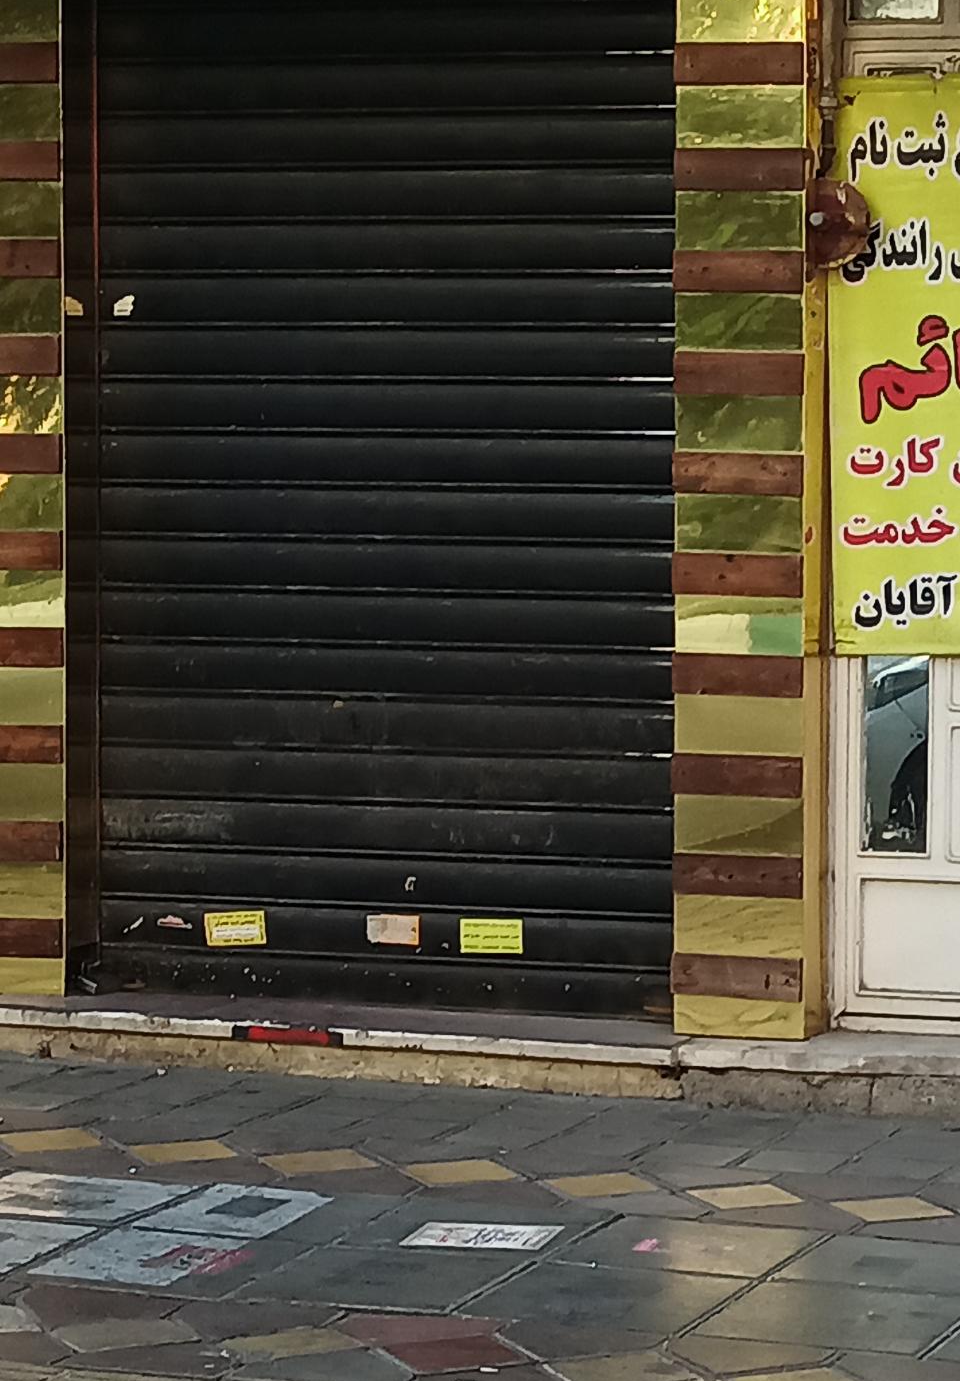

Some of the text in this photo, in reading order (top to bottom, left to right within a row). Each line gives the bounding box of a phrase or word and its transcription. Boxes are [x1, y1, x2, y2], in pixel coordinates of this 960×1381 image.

[850, 120, 888, 182] نام
[896, 113, 946, 177] ثبت
[850, 438, 941, 488] کارت
[841, 508, 956, 547] خدمت
[854, 574, 958, 628] آقایان
